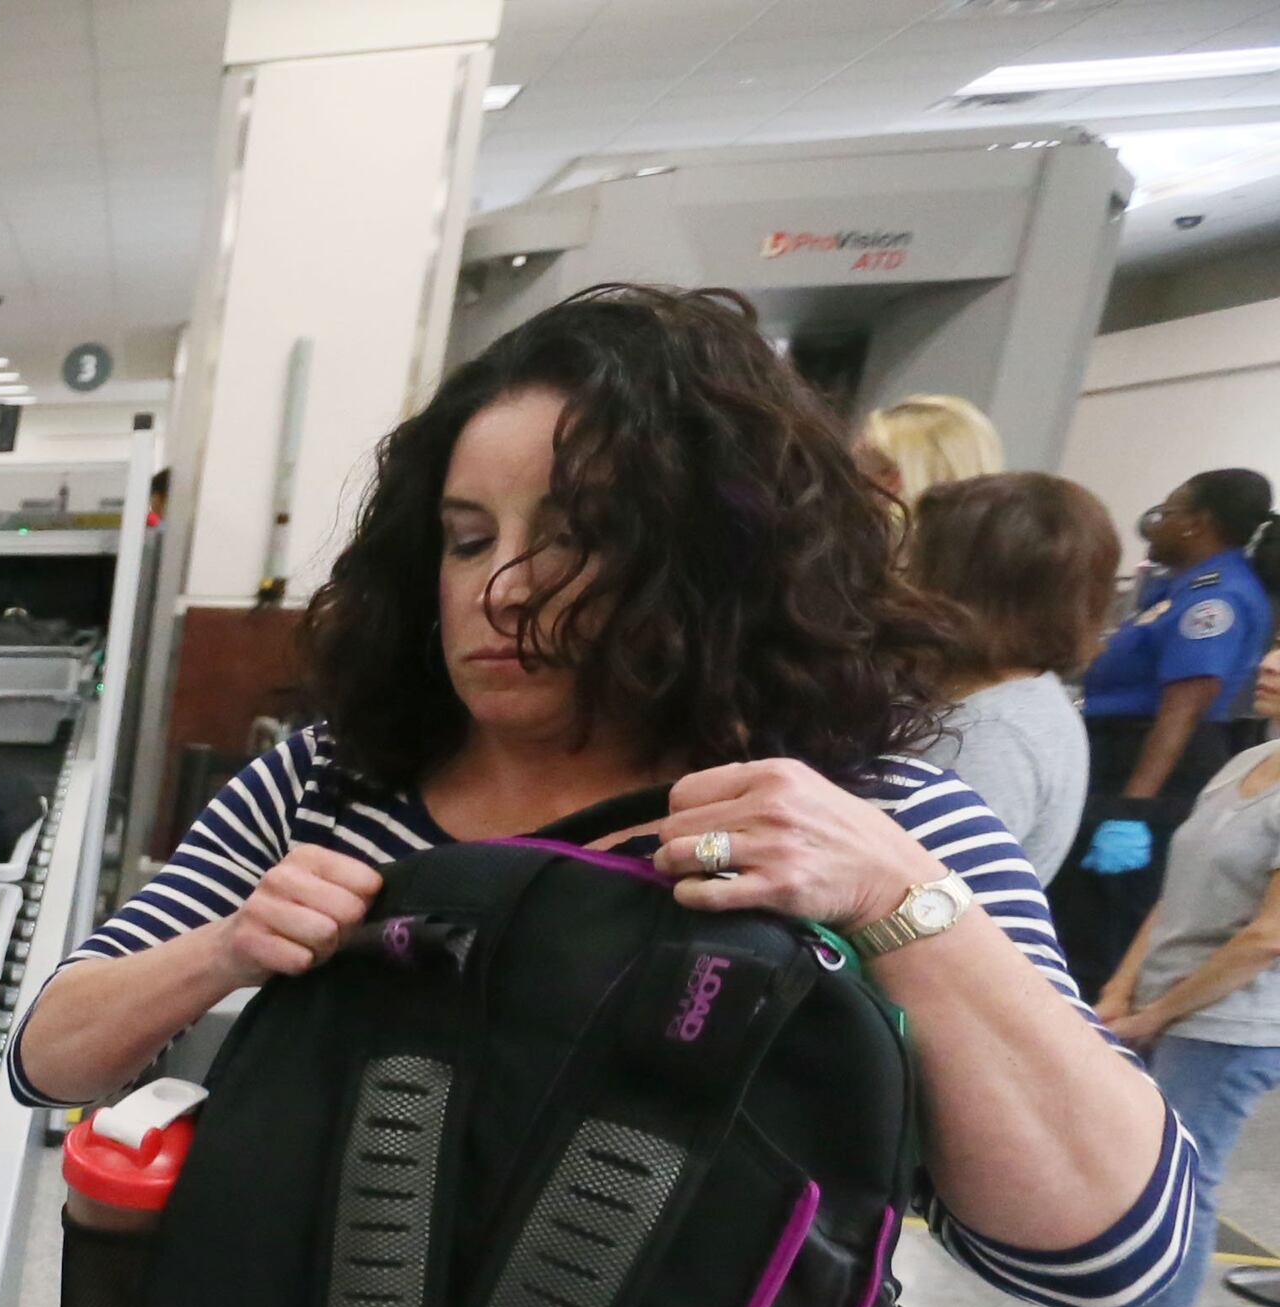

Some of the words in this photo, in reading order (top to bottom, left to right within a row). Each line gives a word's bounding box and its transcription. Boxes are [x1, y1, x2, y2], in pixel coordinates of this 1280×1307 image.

[792, 230, 914, 252] ProVision
[851, 247, 907, 271] ATD
[77, 354, 97, 383] 3
[679, 956, 731, 1042] LOAD
